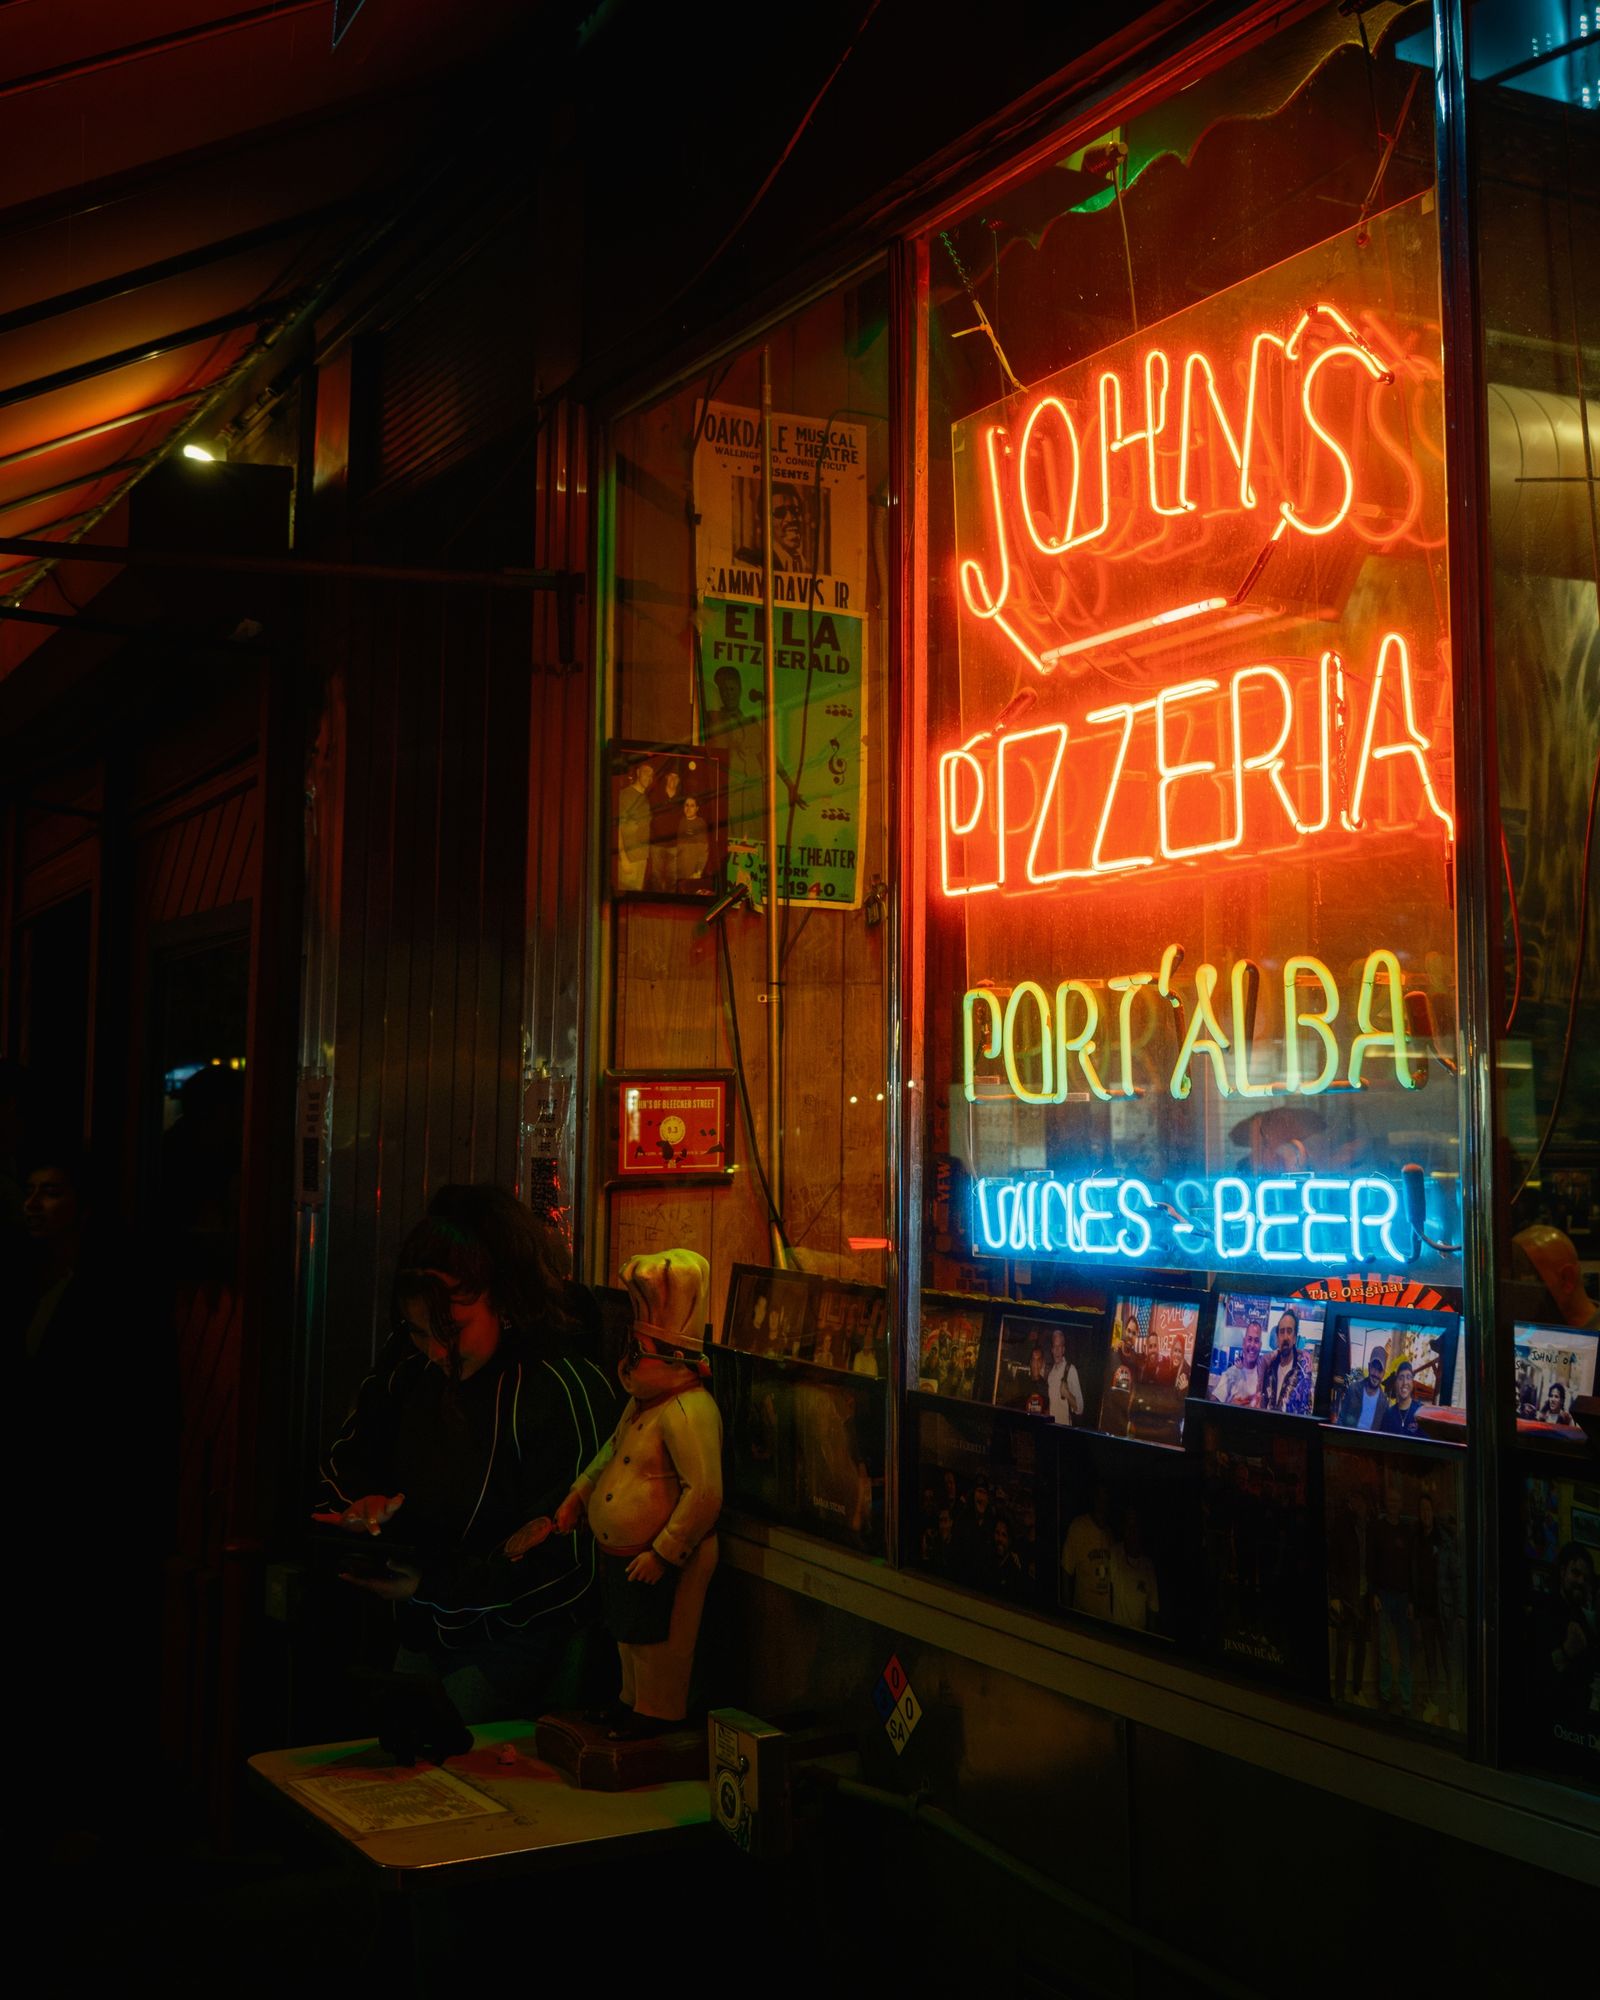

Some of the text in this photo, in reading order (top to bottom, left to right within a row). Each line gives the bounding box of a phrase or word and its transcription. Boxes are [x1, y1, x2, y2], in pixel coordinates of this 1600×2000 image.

[715, 446, 848, 472] WALLINGFD, CONNETICUT
[752, 464, 810, 480] PSENTS
[961, 304, 1393, 617] JOHN'S
[713, 641, 850, 675] FITZERALD
[940, 634, 1454, 896] PIZZERIA
[799, 847, 856, 869] THEATER
[693, 1098, 715, 1109] STREET
[977, 1177, 1153, 1258] WINES
[1213, 1177, 1407, 1264] BEER
[1308, 1282, 1405, 1301] The Original
